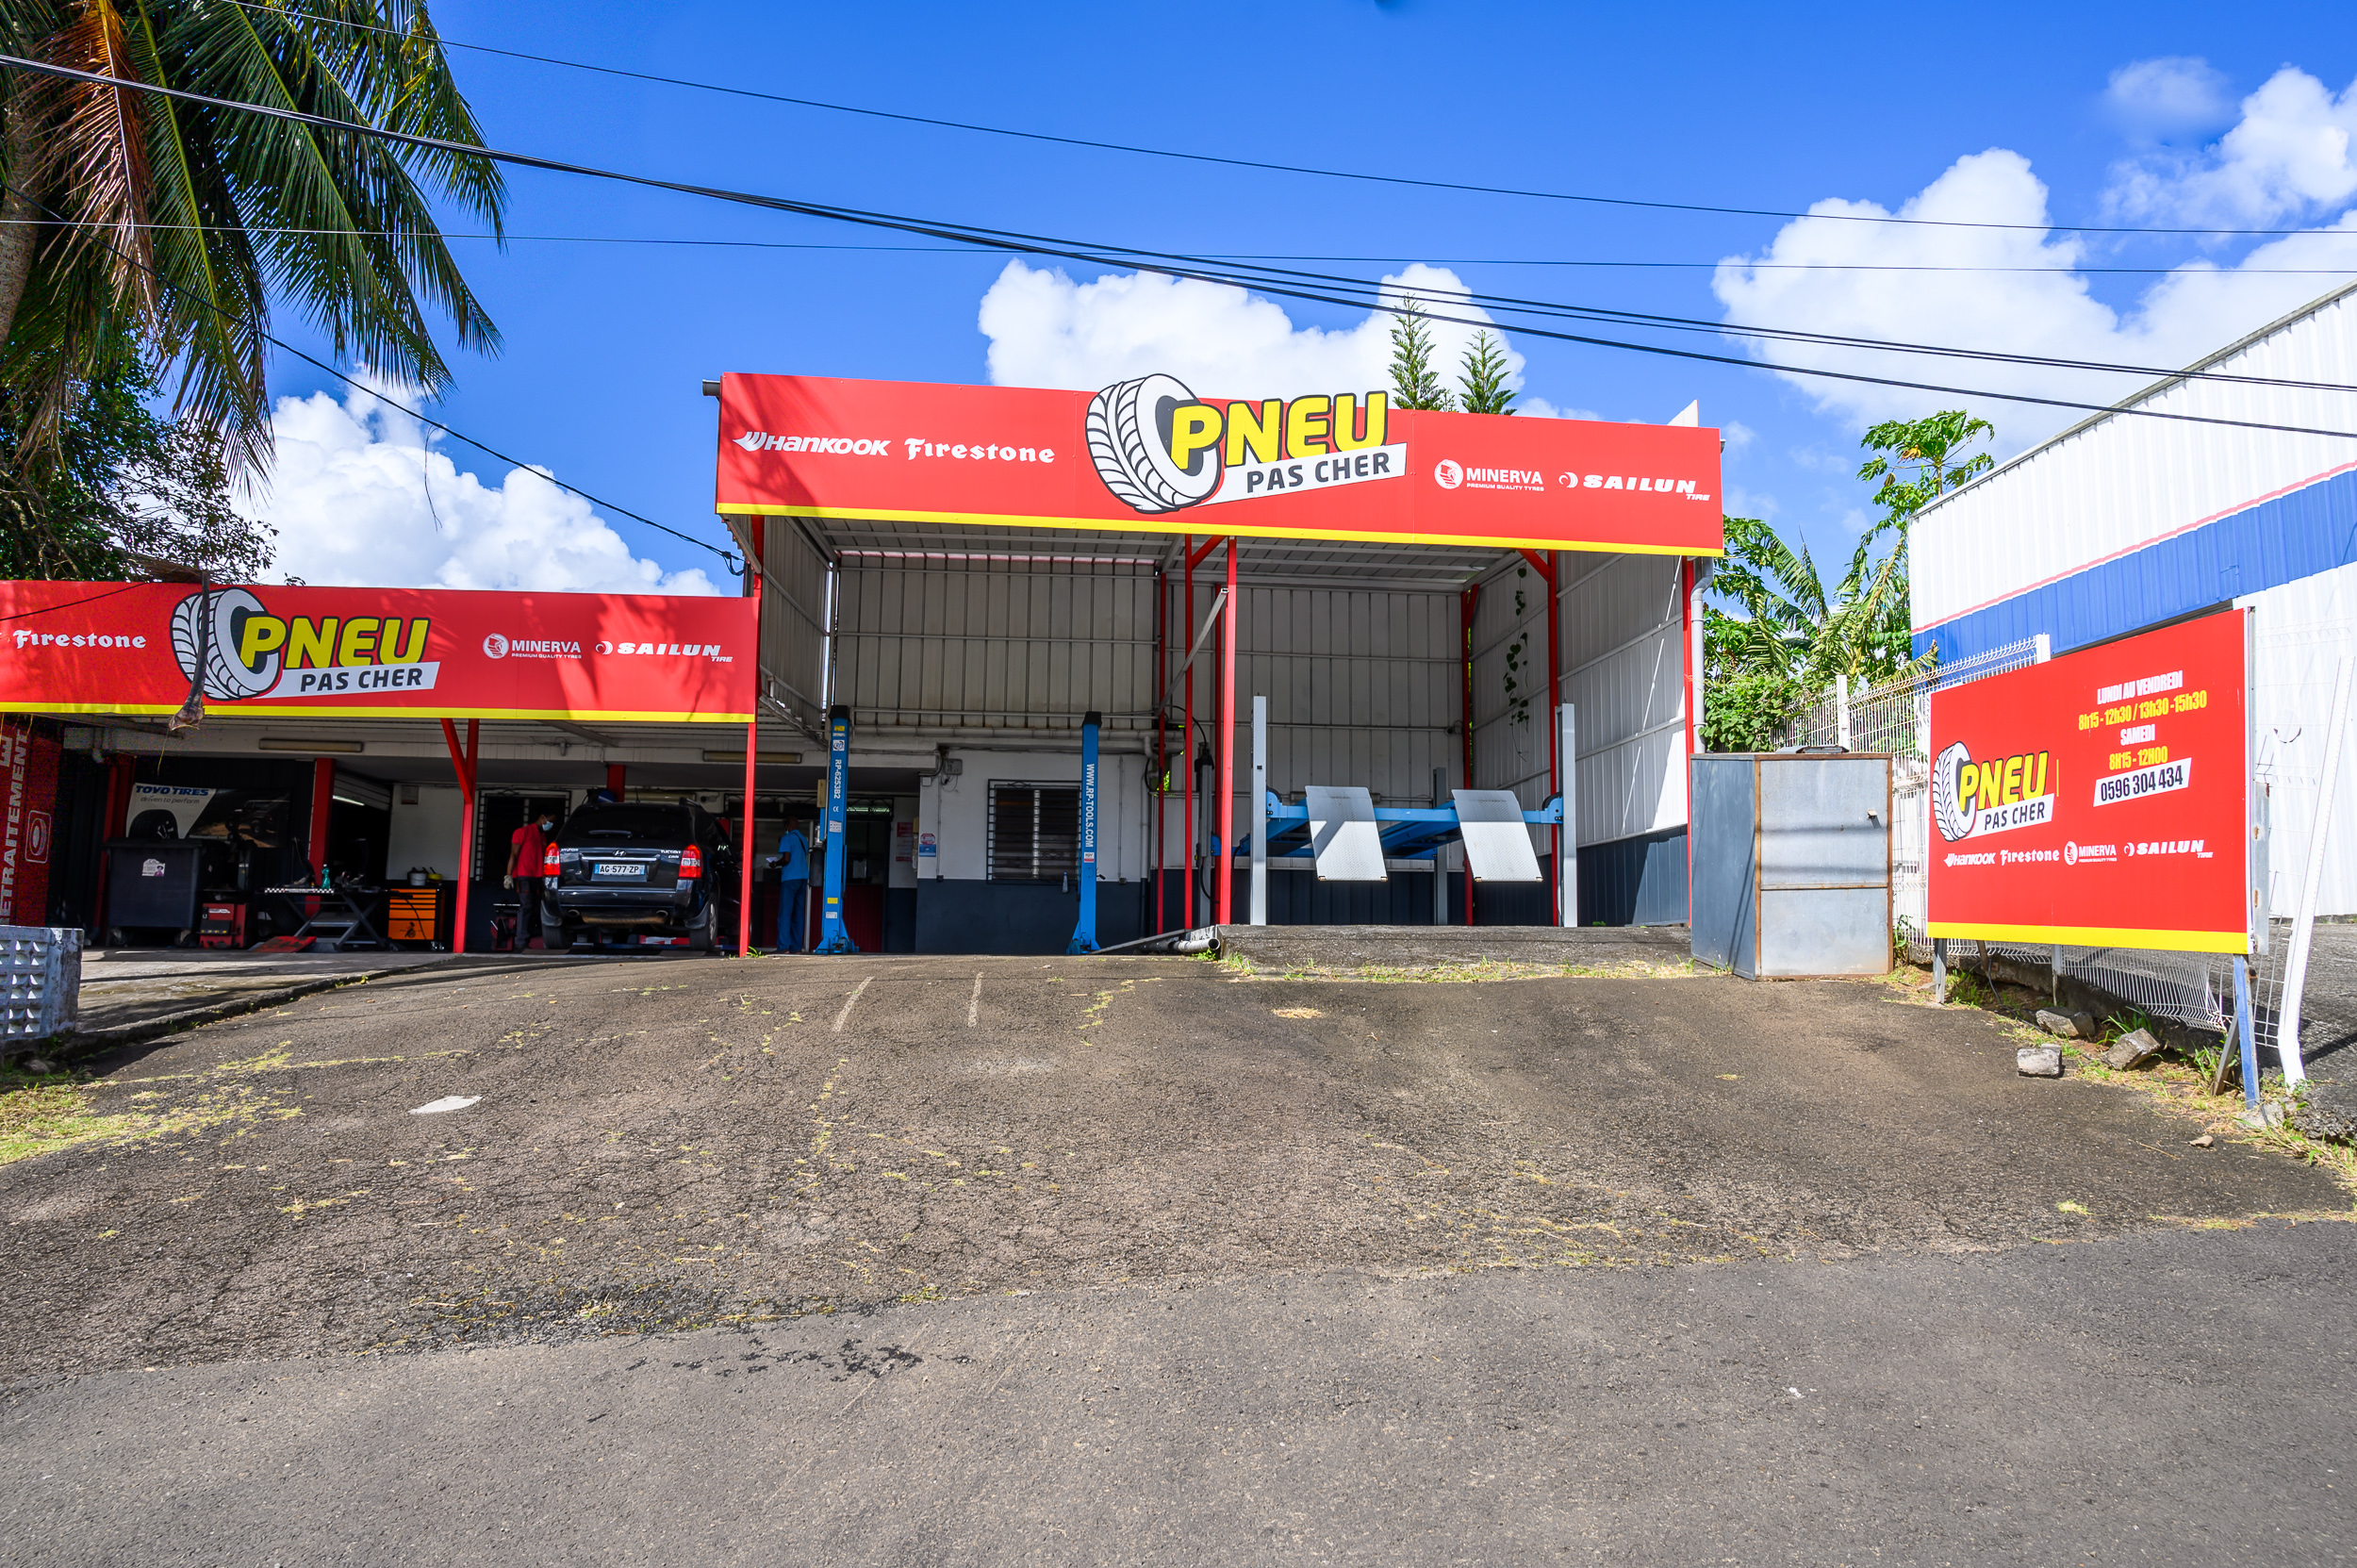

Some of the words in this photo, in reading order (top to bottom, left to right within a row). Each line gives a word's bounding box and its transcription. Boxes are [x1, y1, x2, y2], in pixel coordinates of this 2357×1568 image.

[1169, 391, 1389, 470] PNEU
[904, 437, 1056, 463] Firestone
[1246, 465, 1304, 493] PAS
[1314, 452, 1391, 483] CHER
[1466, 468, 1543, 485] MINERVA
[1583, 474, 1696, 493] SAILUN
[12, 629, 146, 649] Firestone
[239, 616, 431, 668] PNEU
[511, 639, 582, 652] MINERVA
[618, 642, 720, 656] SAILUN
[300, 671, 349, 692] PAS
[358, 668, 423, 688] CHER
[2097, 684, 2122, 704] LUNDI
[2123, 681, 2135, 700] AU
[2136, 670, 2184, 696] VENDREDI
[2078, 711, 2100, 731] 8h15
[2104, 704, 2133, 726] 12h30
[2138, 698, 2169, 719] 13h30
[2120, 724, 2155, 746] SAMEDI
[2109, 751, 2132, 770] 8H15
[2137, 746, 2168, 767] 12H00
[136, 785, 171, 795] TOYO
[173, 787, 209, 797] TIRES
[833, 759, 842, 800] RP-6253B2
[1958, 751, 2049, 812] PNEU
[2101, 778, 2130, 801] 0596
[2133, 771, 2156, 795] 304
[2158, 765, 2184, 789] 434
[140, 795, 163, 803] driven
[1085, 764, 1096, 848] WWW.RP-TOOLS.COM
[1985, 810, 2007, 831] PAS
[2012, 801, 2045, 825] CHER
[2000, 849, 2060, 867] Firestone
[2078, 844, 2117, 857] MINERVA
[2136, 839, 2204, 855] SAILUN
